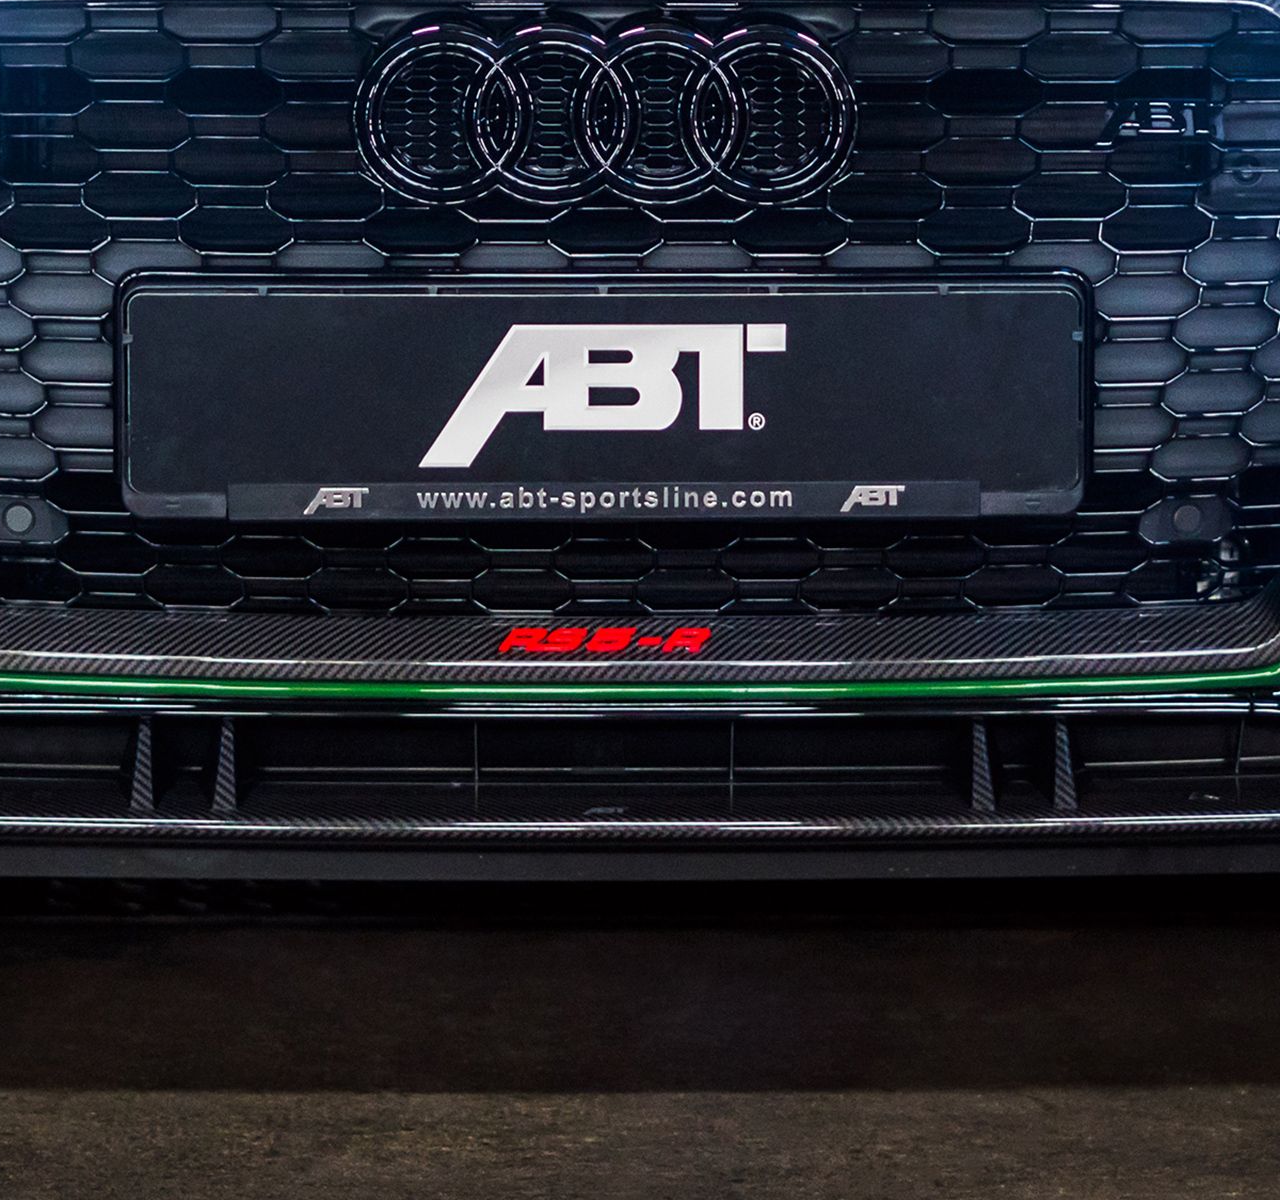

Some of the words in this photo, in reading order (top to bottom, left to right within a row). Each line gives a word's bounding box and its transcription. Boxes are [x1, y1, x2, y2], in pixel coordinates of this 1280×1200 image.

[1095, 99, 1225, 146] ABT
[418, 323, 786, 468] ABT
[303, 487, 369, 515] ABT
[417, 486, 793, 513] www.abt-sportsline.com
[840, 485, 906, 513] ABT
